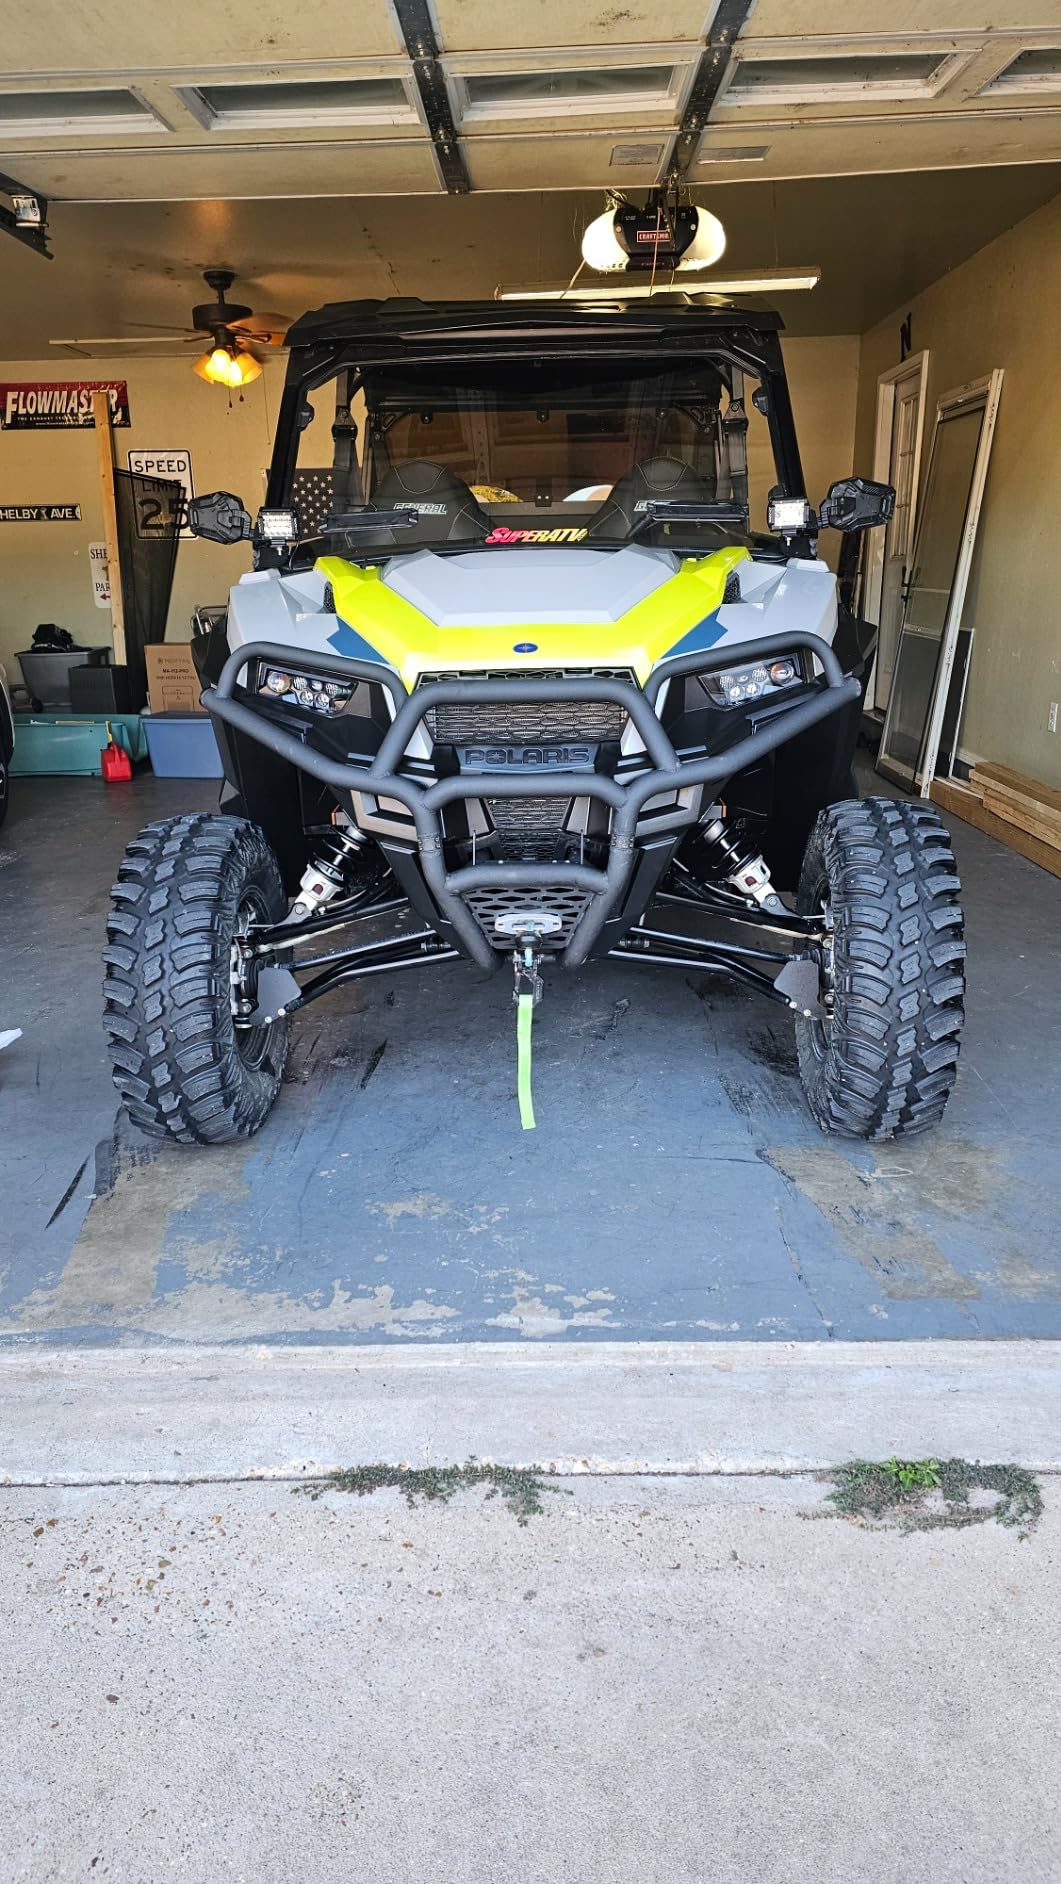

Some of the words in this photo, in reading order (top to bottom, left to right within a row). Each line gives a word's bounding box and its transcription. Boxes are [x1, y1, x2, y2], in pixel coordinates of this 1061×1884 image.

[5, 389, 118, 424] FLOWMASTR
[134, 460, 187, 473] SPEED
[0, 508, 38, 519] HELBY
[139, 498, 190, 530] 25
[465, 747, 590, 765] POLARIS
